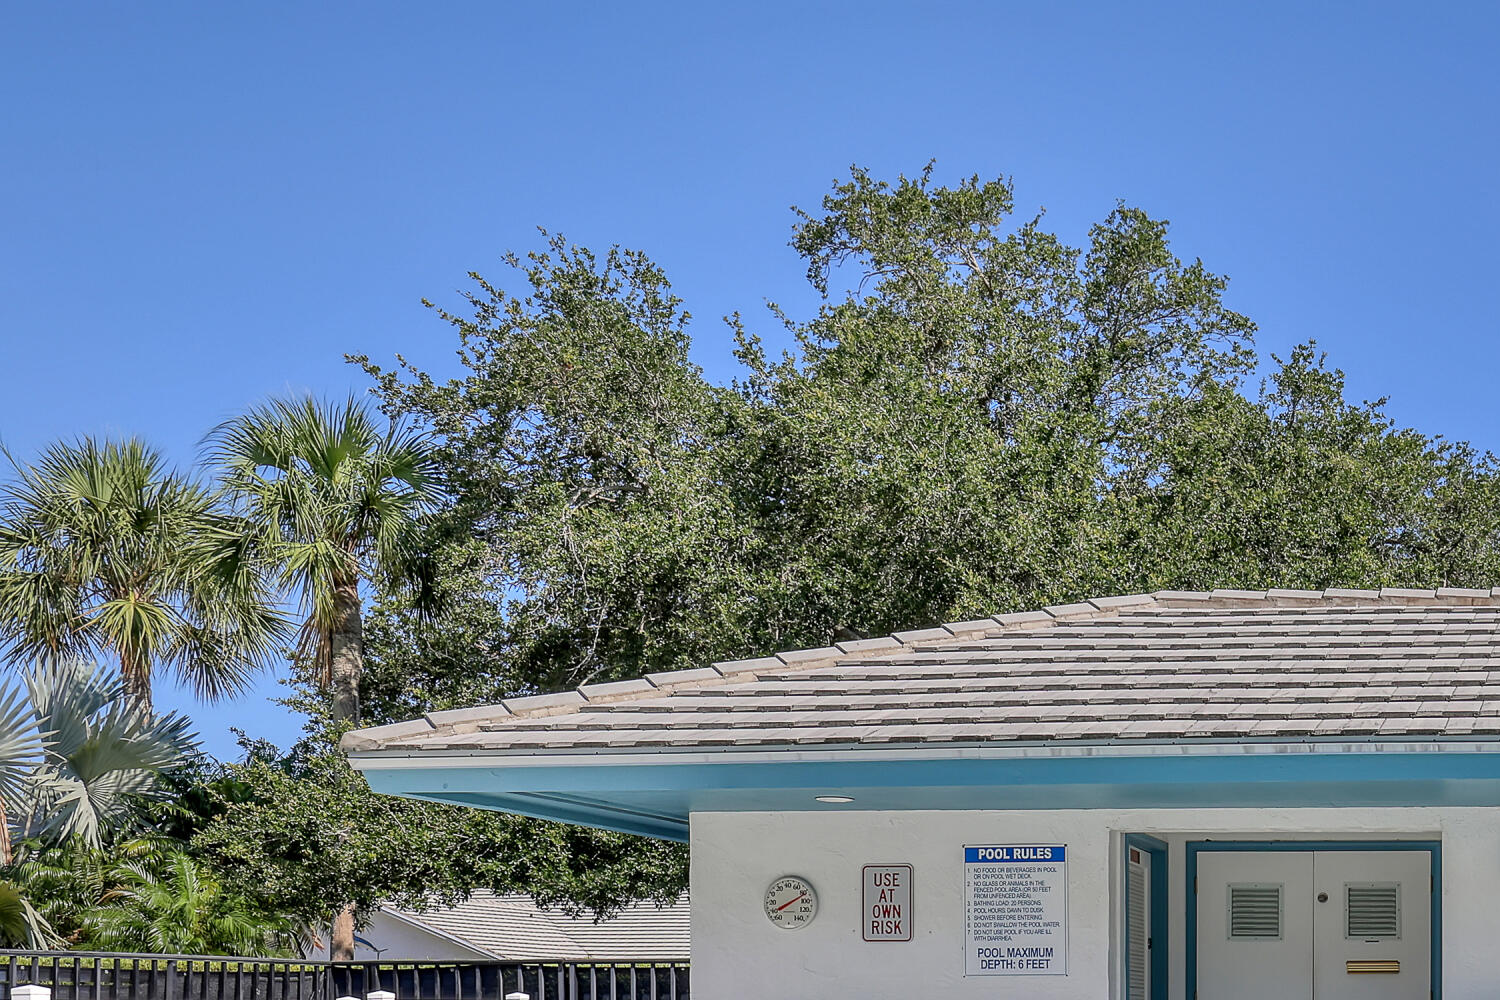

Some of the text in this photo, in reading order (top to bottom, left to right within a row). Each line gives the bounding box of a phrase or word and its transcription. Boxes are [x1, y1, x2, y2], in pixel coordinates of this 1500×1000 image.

[978, 848, 1052, 860] POOL RULES
[873, 873, 900, 886] USE
[879, 889, 895, 903] AT
[873, 905, 901, 918] OWN
[871, 921, 902, 934] RISK
[978, 948, 1053, 958] POOL MAXIMUM
[981, 959, 1050, 969] DEPTH: 6 FEET
